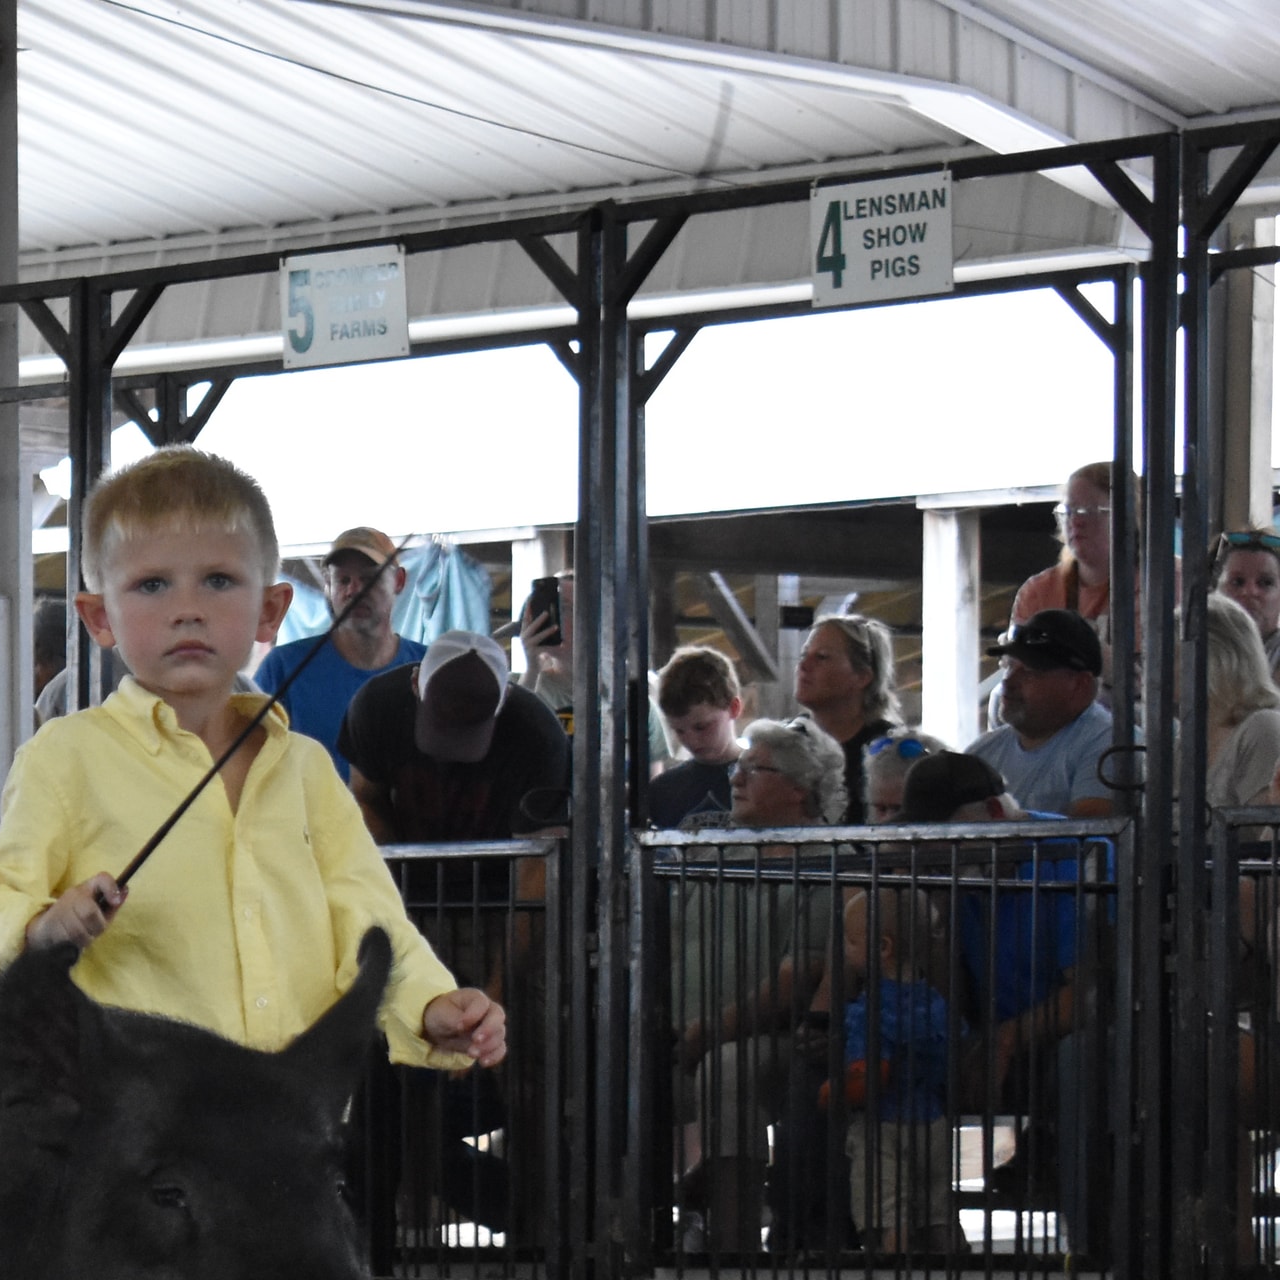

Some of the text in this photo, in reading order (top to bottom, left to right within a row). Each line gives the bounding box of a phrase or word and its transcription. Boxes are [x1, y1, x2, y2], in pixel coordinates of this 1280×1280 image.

[843, 187, 947, 220] LENSMAN
[816, 200, 846, 289] 4
[862, 221, 928, 250] SHOW
[870, 254, 921, 280] PIGS
[288, 269, 314, 354] 5
[330, 318, 388, 341] FARMS
